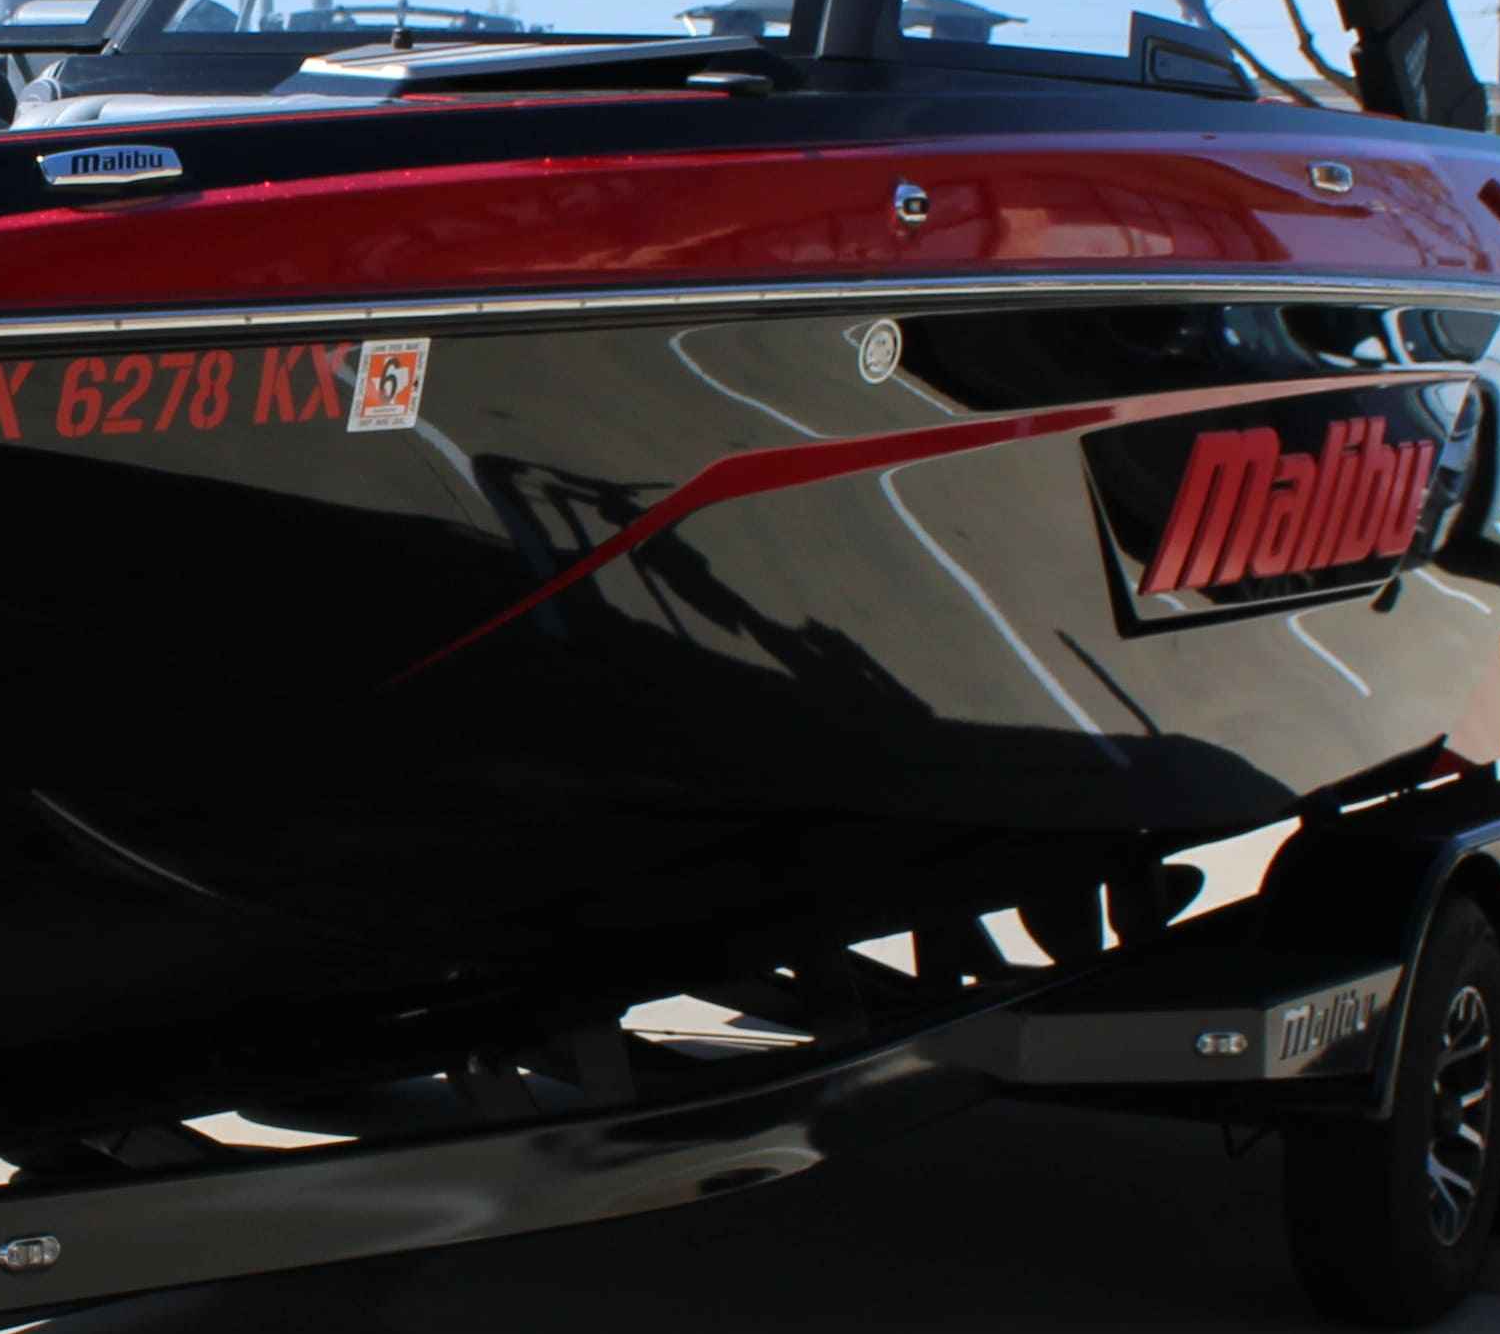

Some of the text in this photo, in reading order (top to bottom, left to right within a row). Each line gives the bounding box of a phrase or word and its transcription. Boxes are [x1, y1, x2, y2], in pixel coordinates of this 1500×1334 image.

[71, 150, 163, 175] Malibu
[56, 349, 234, 439] 6278
[254, 340, 356, 425] KX
[379, 357, 401, 402] 6
[1138, 415, 1435, 596] Malibu
